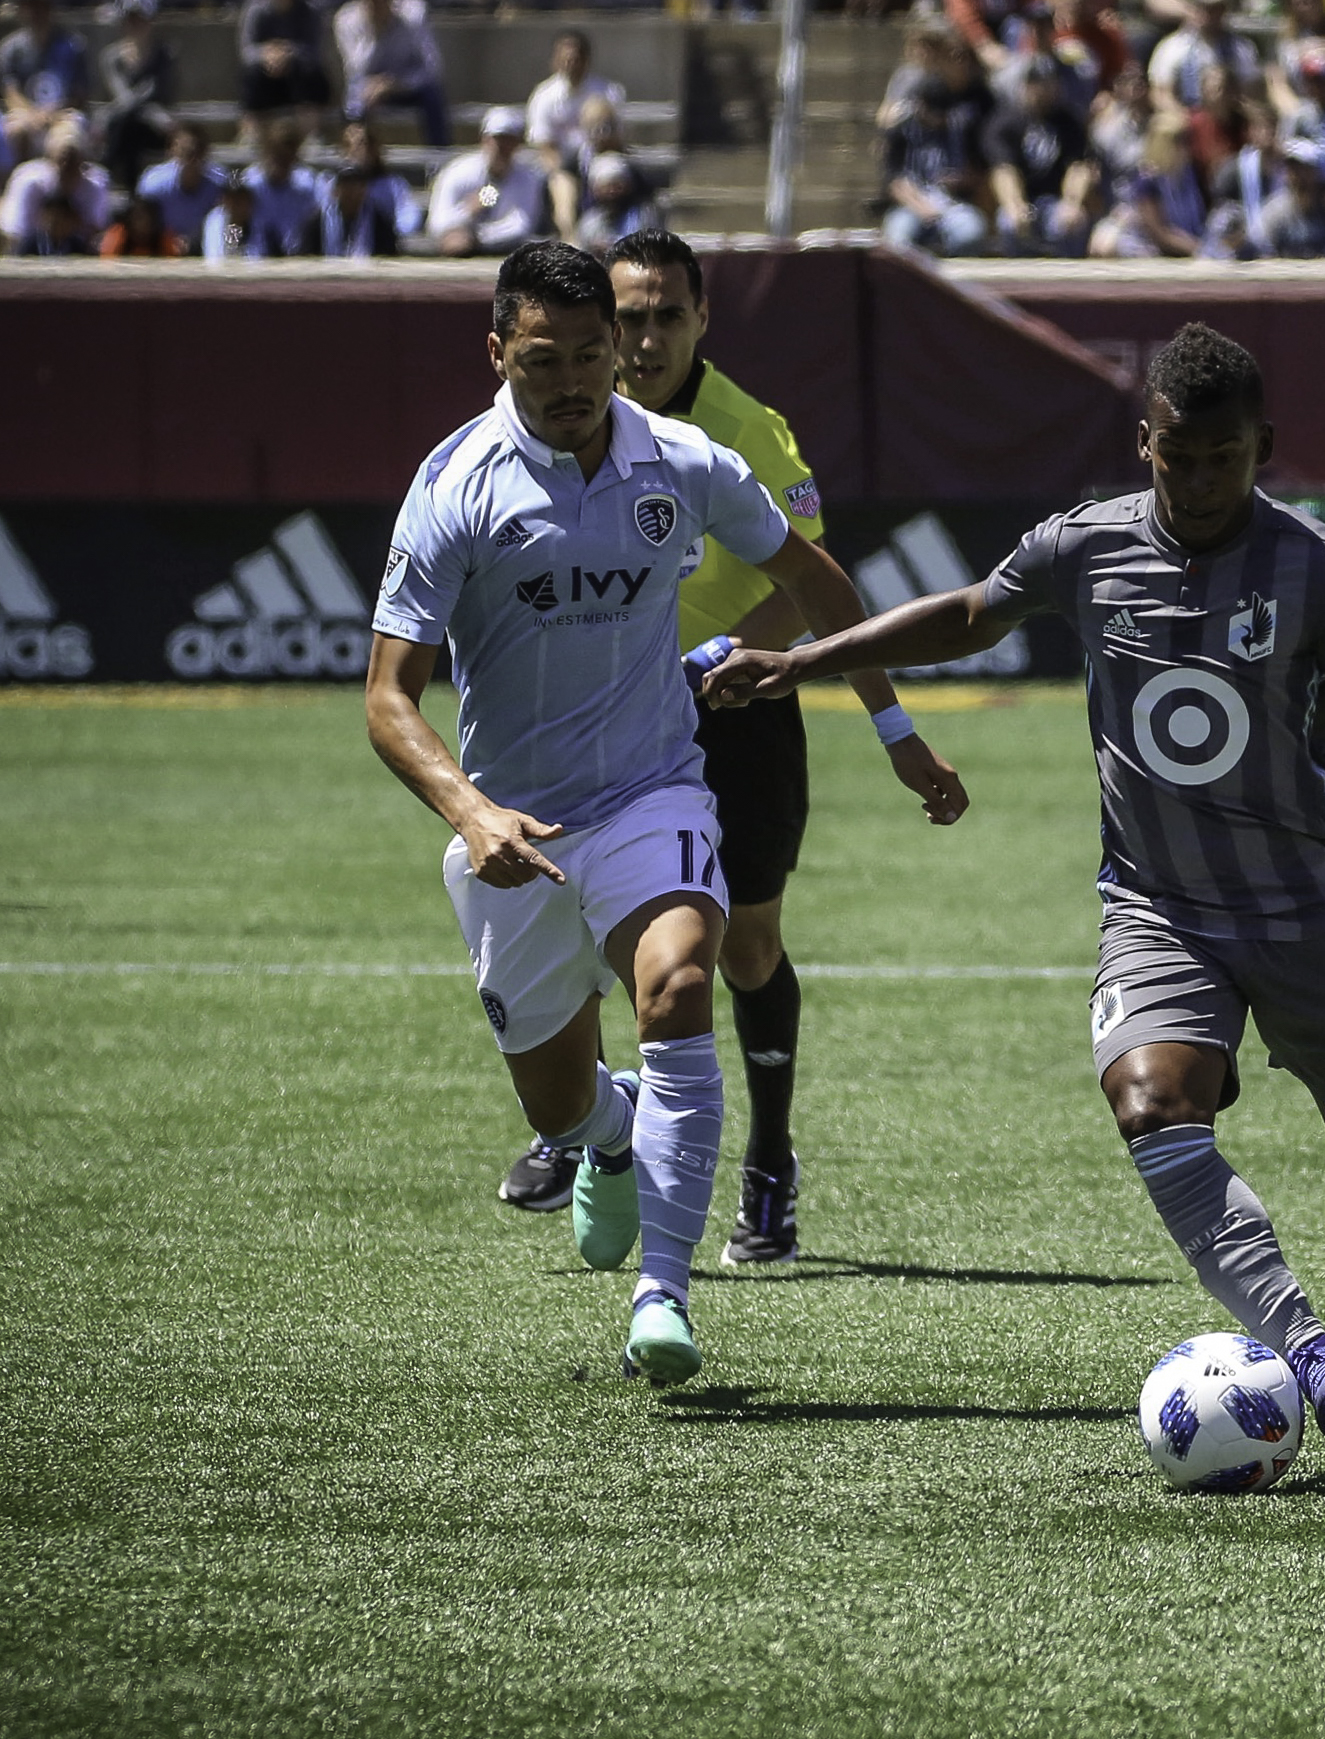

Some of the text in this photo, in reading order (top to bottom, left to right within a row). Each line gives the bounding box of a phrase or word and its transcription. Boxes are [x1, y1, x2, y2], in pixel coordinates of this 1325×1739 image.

[787, 482, 814, 500] TAG
[496, 532, 535, 548] adidas
[570, 565, 653, 607] Ivy
[1103, 624, 1142, 638] adidas
[165, 612, 376, 679] adida
